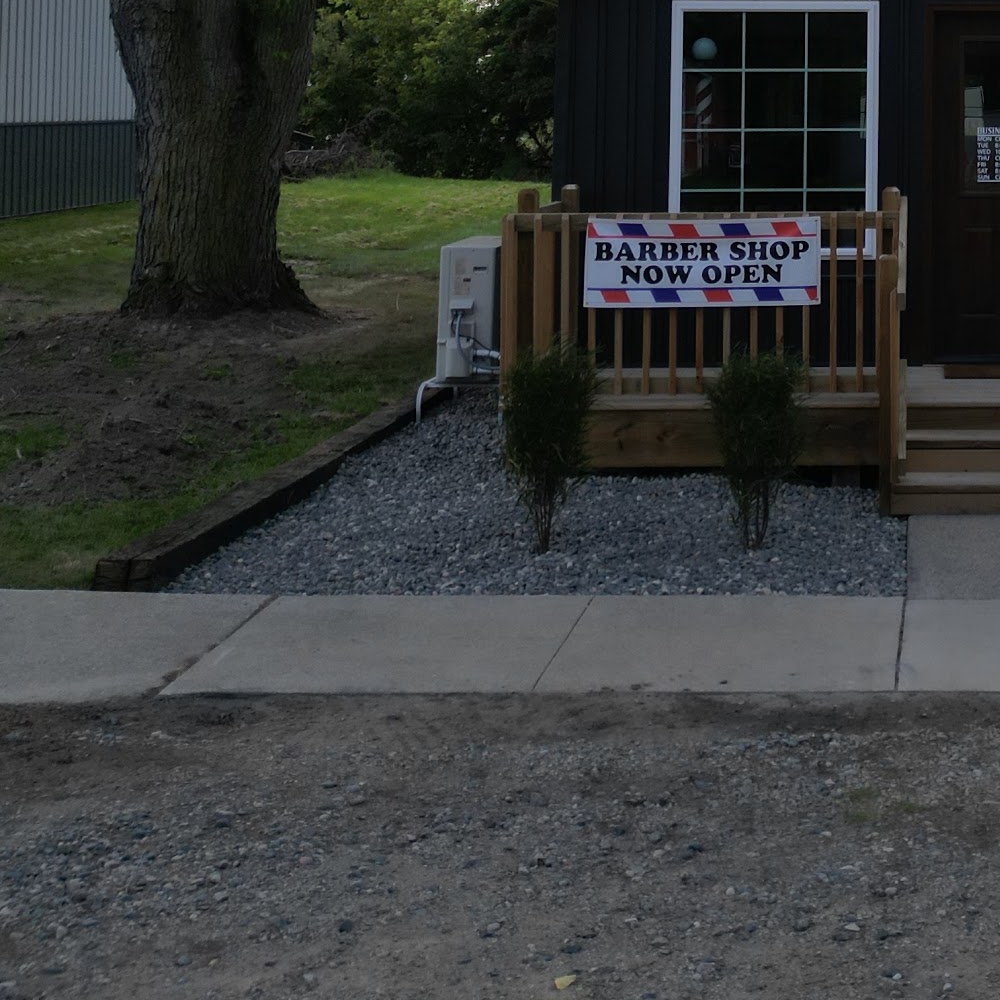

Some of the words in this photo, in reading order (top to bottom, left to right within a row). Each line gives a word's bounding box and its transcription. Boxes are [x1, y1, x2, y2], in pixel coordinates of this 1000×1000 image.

[594, 241, 720, 262] BARBER
[729, 240, 810, 261] SHOP
[620, 265, 693, 285] NOW
[701, 264, 783, 284] OPEN
